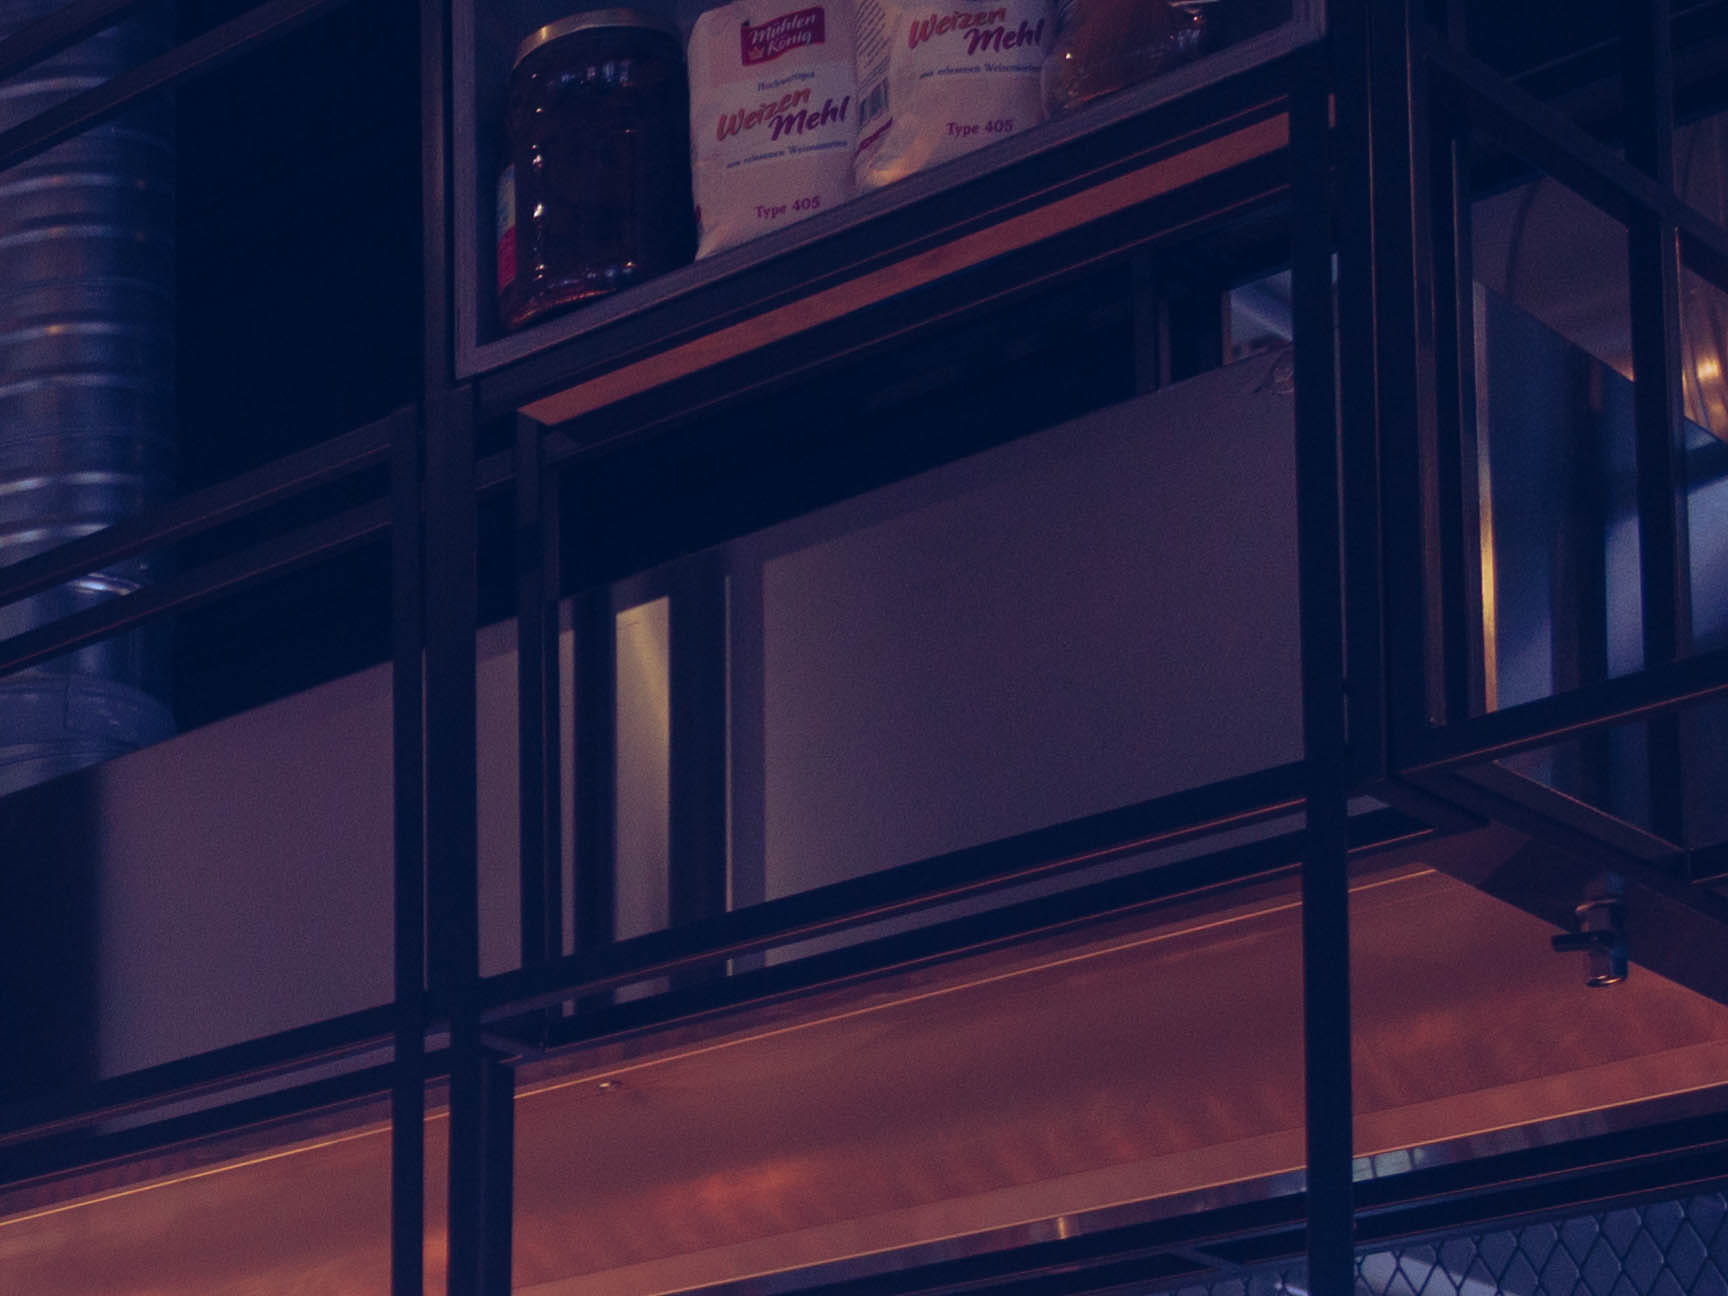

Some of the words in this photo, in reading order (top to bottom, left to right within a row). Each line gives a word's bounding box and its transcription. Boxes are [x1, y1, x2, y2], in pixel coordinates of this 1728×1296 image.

[908, 8, 1006, 49] Weizen
[963, 18, 1045, 56] Mehl
[716, 88, 811, 142] Weizen
[767, 96, 850, 141] Mehl
[946, 121, 980, 139] Type
[985, 119, 1014, 133] 405
[754, 203, 788, 221] Type
[792, 196, 821, 211] 405
